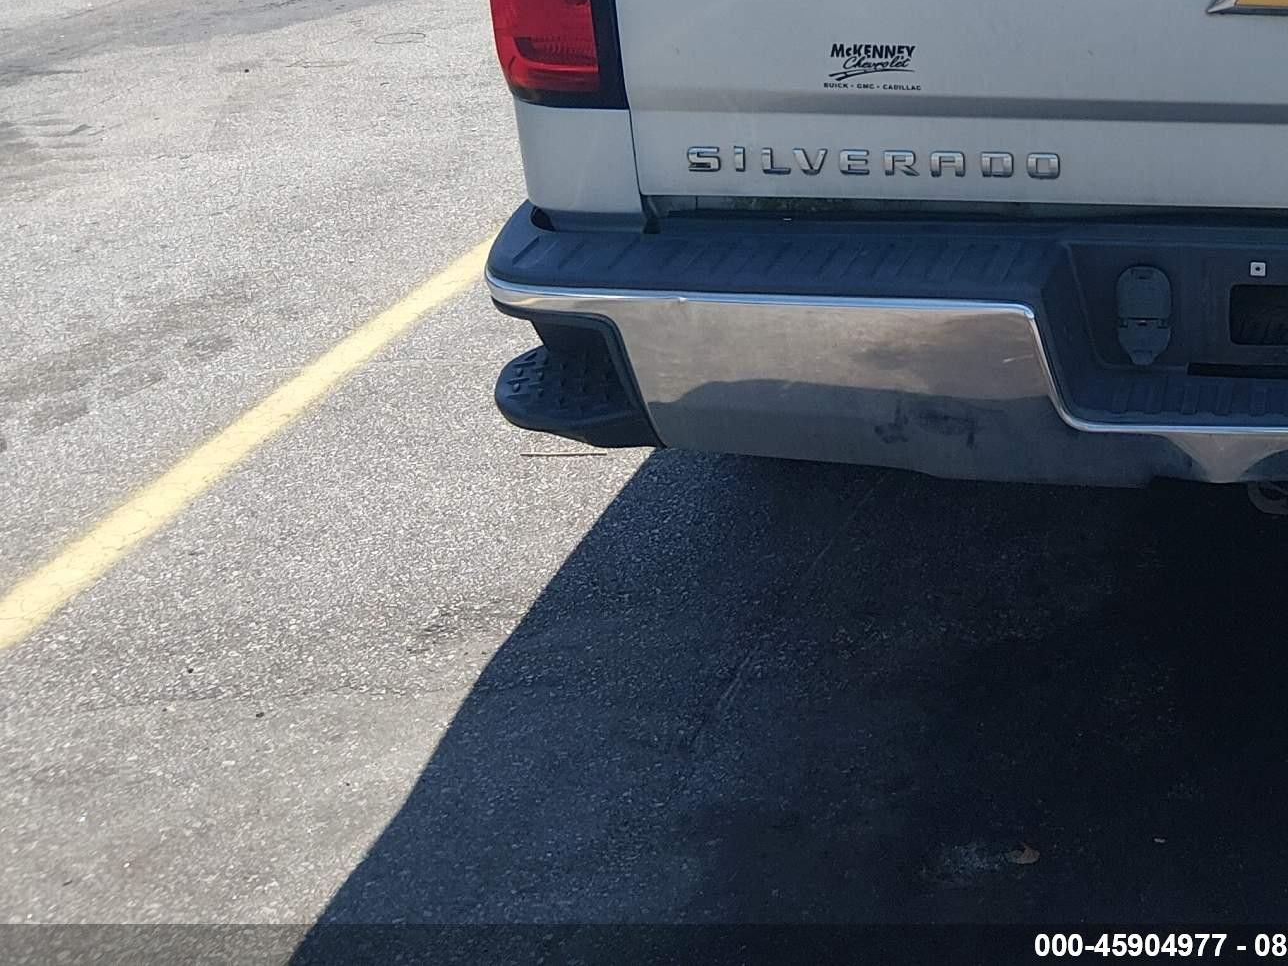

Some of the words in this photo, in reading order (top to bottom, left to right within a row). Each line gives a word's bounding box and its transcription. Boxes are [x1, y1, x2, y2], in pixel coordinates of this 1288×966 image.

[842, 55, 911, 70] Chevrolet
[882, 83, 922, 91] CADILLAC
[686, 146, 1062, 180] SILVERADO
